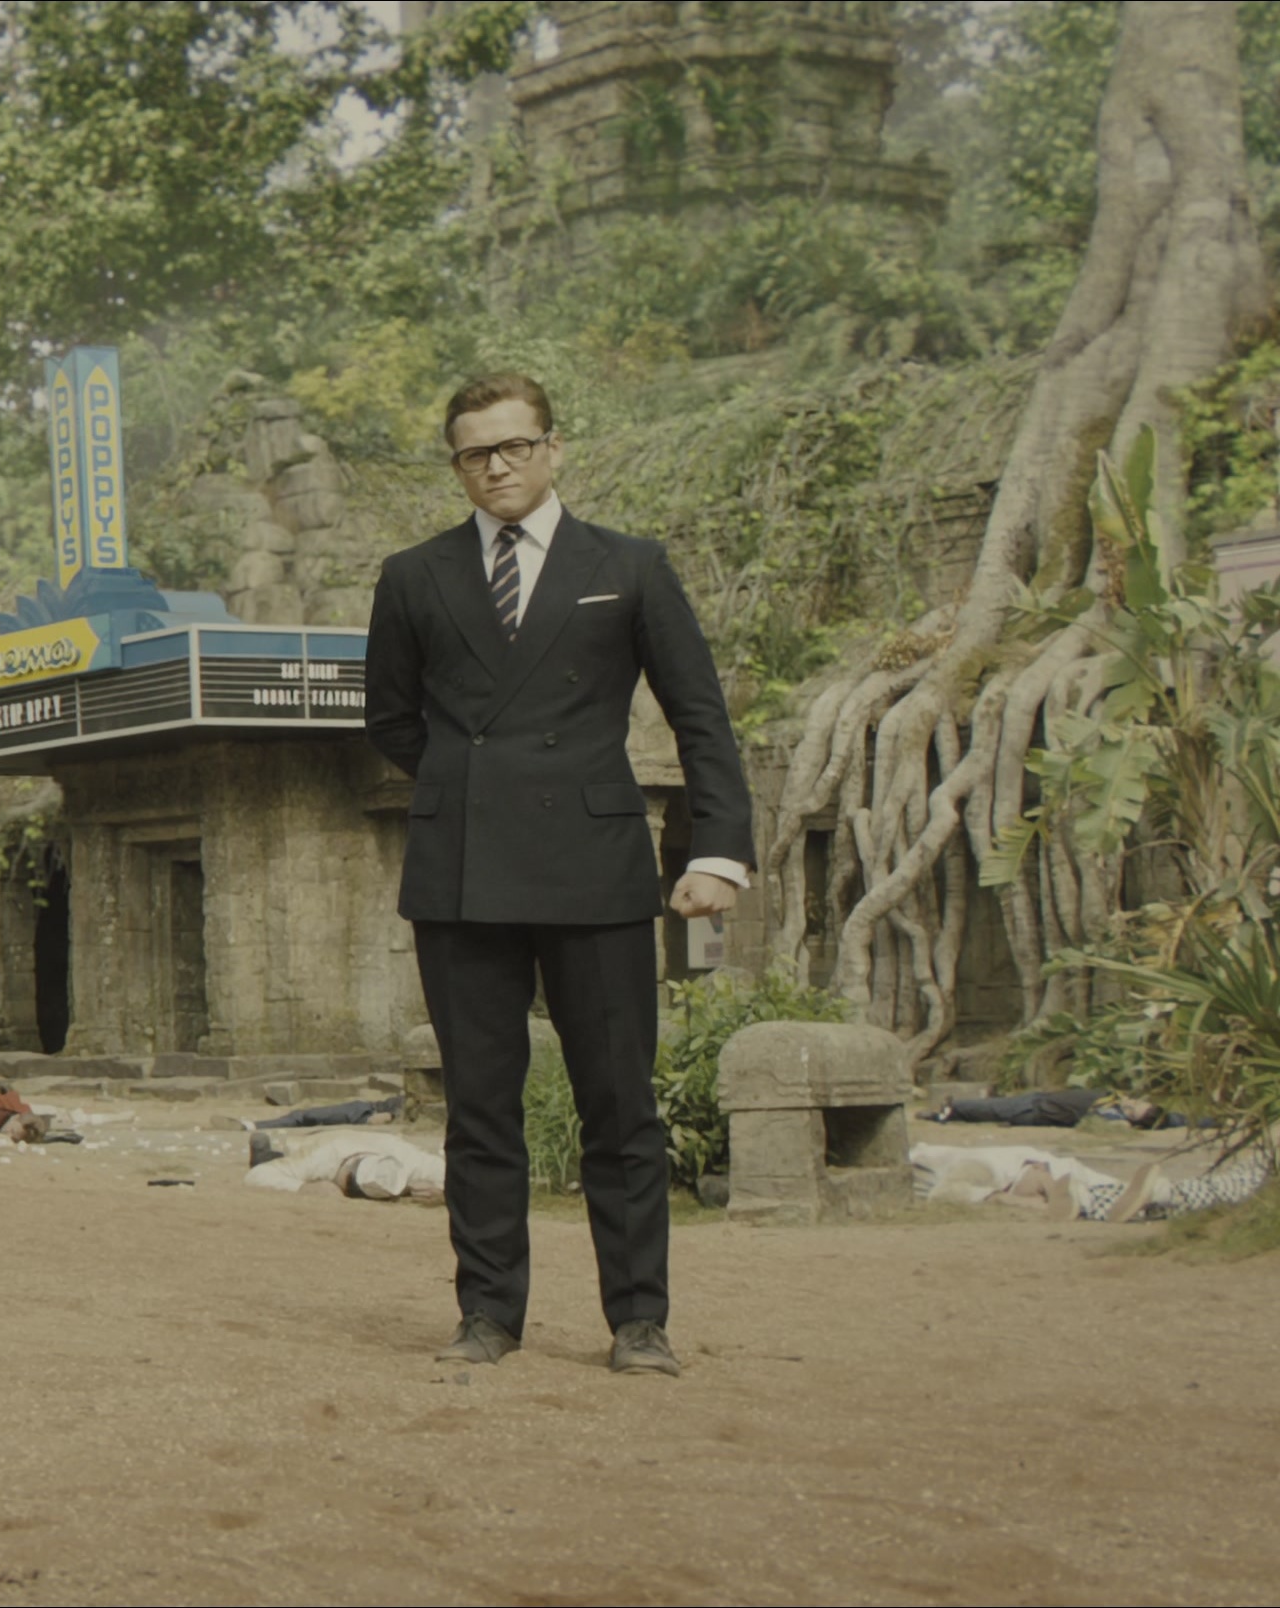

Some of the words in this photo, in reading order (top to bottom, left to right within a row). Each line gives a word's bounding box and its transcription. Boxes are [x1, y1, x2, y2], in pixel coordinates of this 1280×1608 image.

[54, 385, 78, 567] POPPYS
[90, 383, 118, 564] POPPYS
[253, 688, 301, 706] DOUBLE
